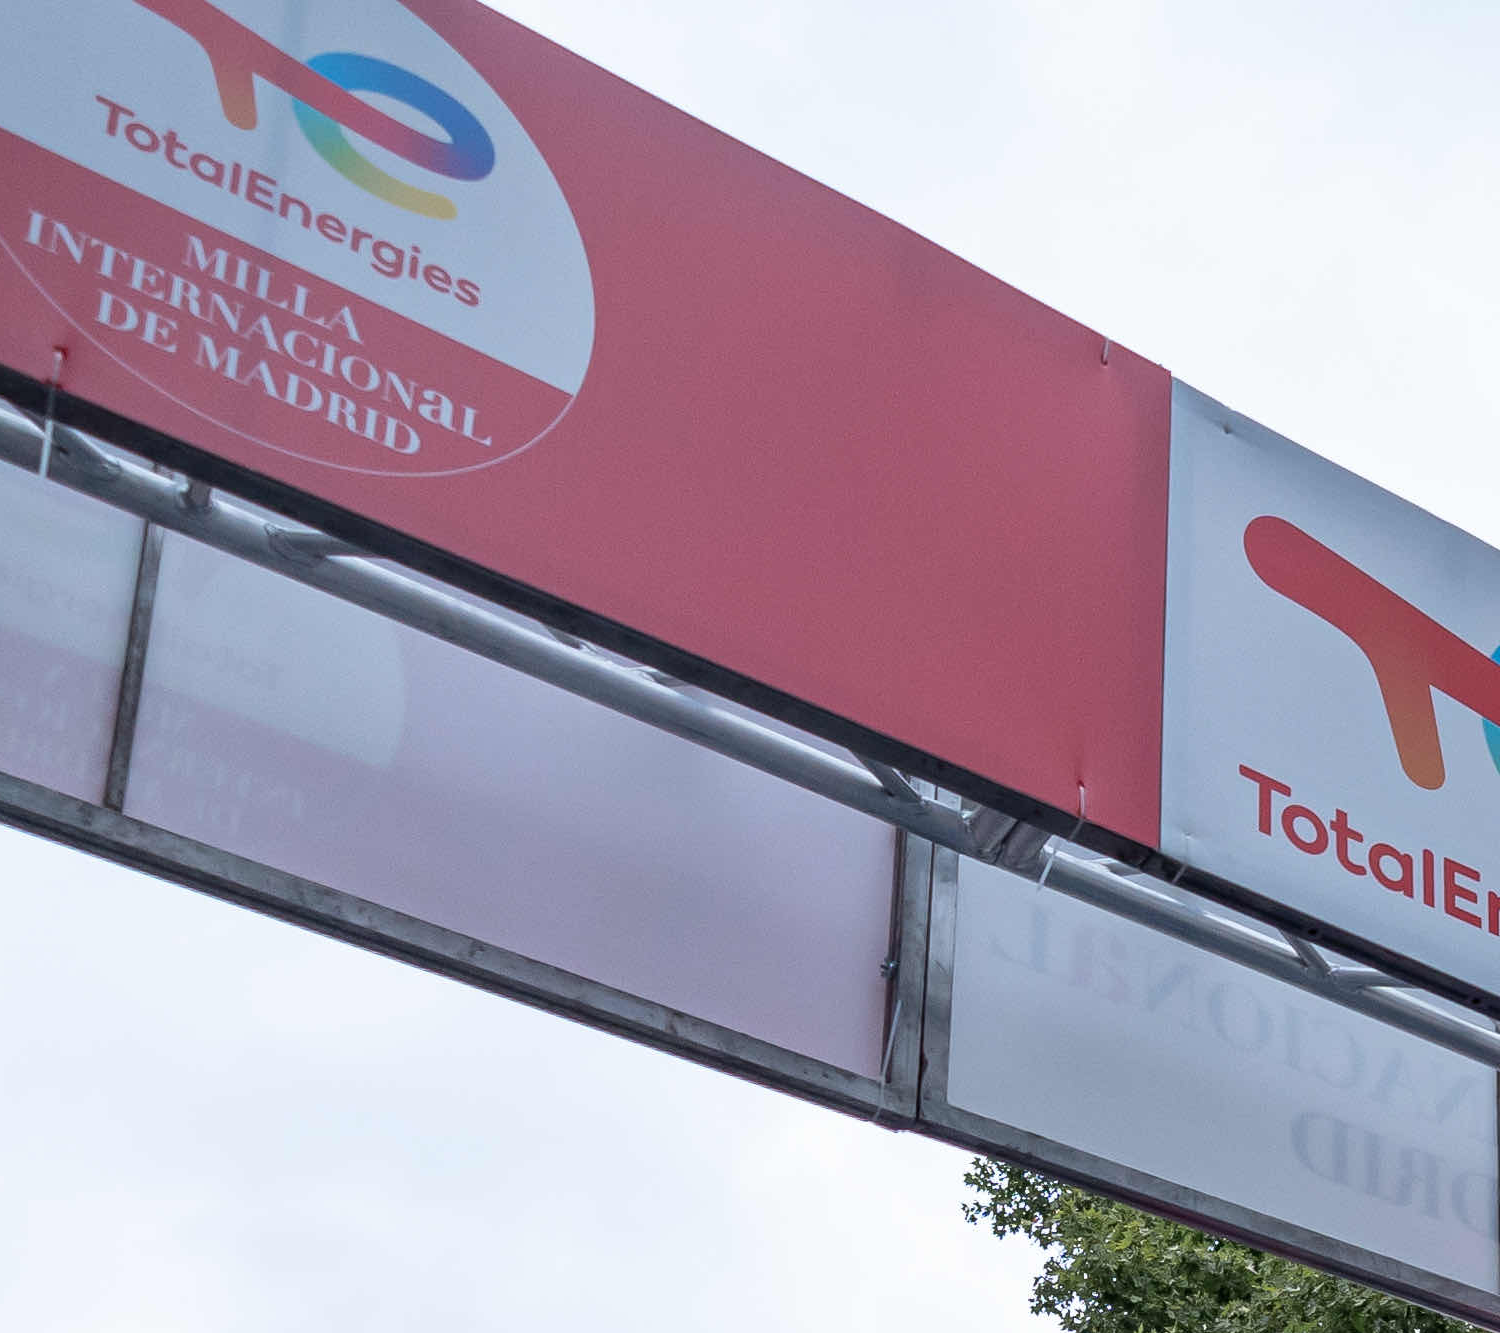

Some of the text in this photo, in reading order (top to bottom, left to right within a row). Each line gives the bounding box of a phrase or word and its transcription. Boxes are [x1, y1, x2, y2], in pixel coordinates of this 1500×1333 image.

[96, 94, 482, 307] TotalEnergies
[182, 235, 366, 344] MILLA
[93, 291, 422, 457] DE MADRID
